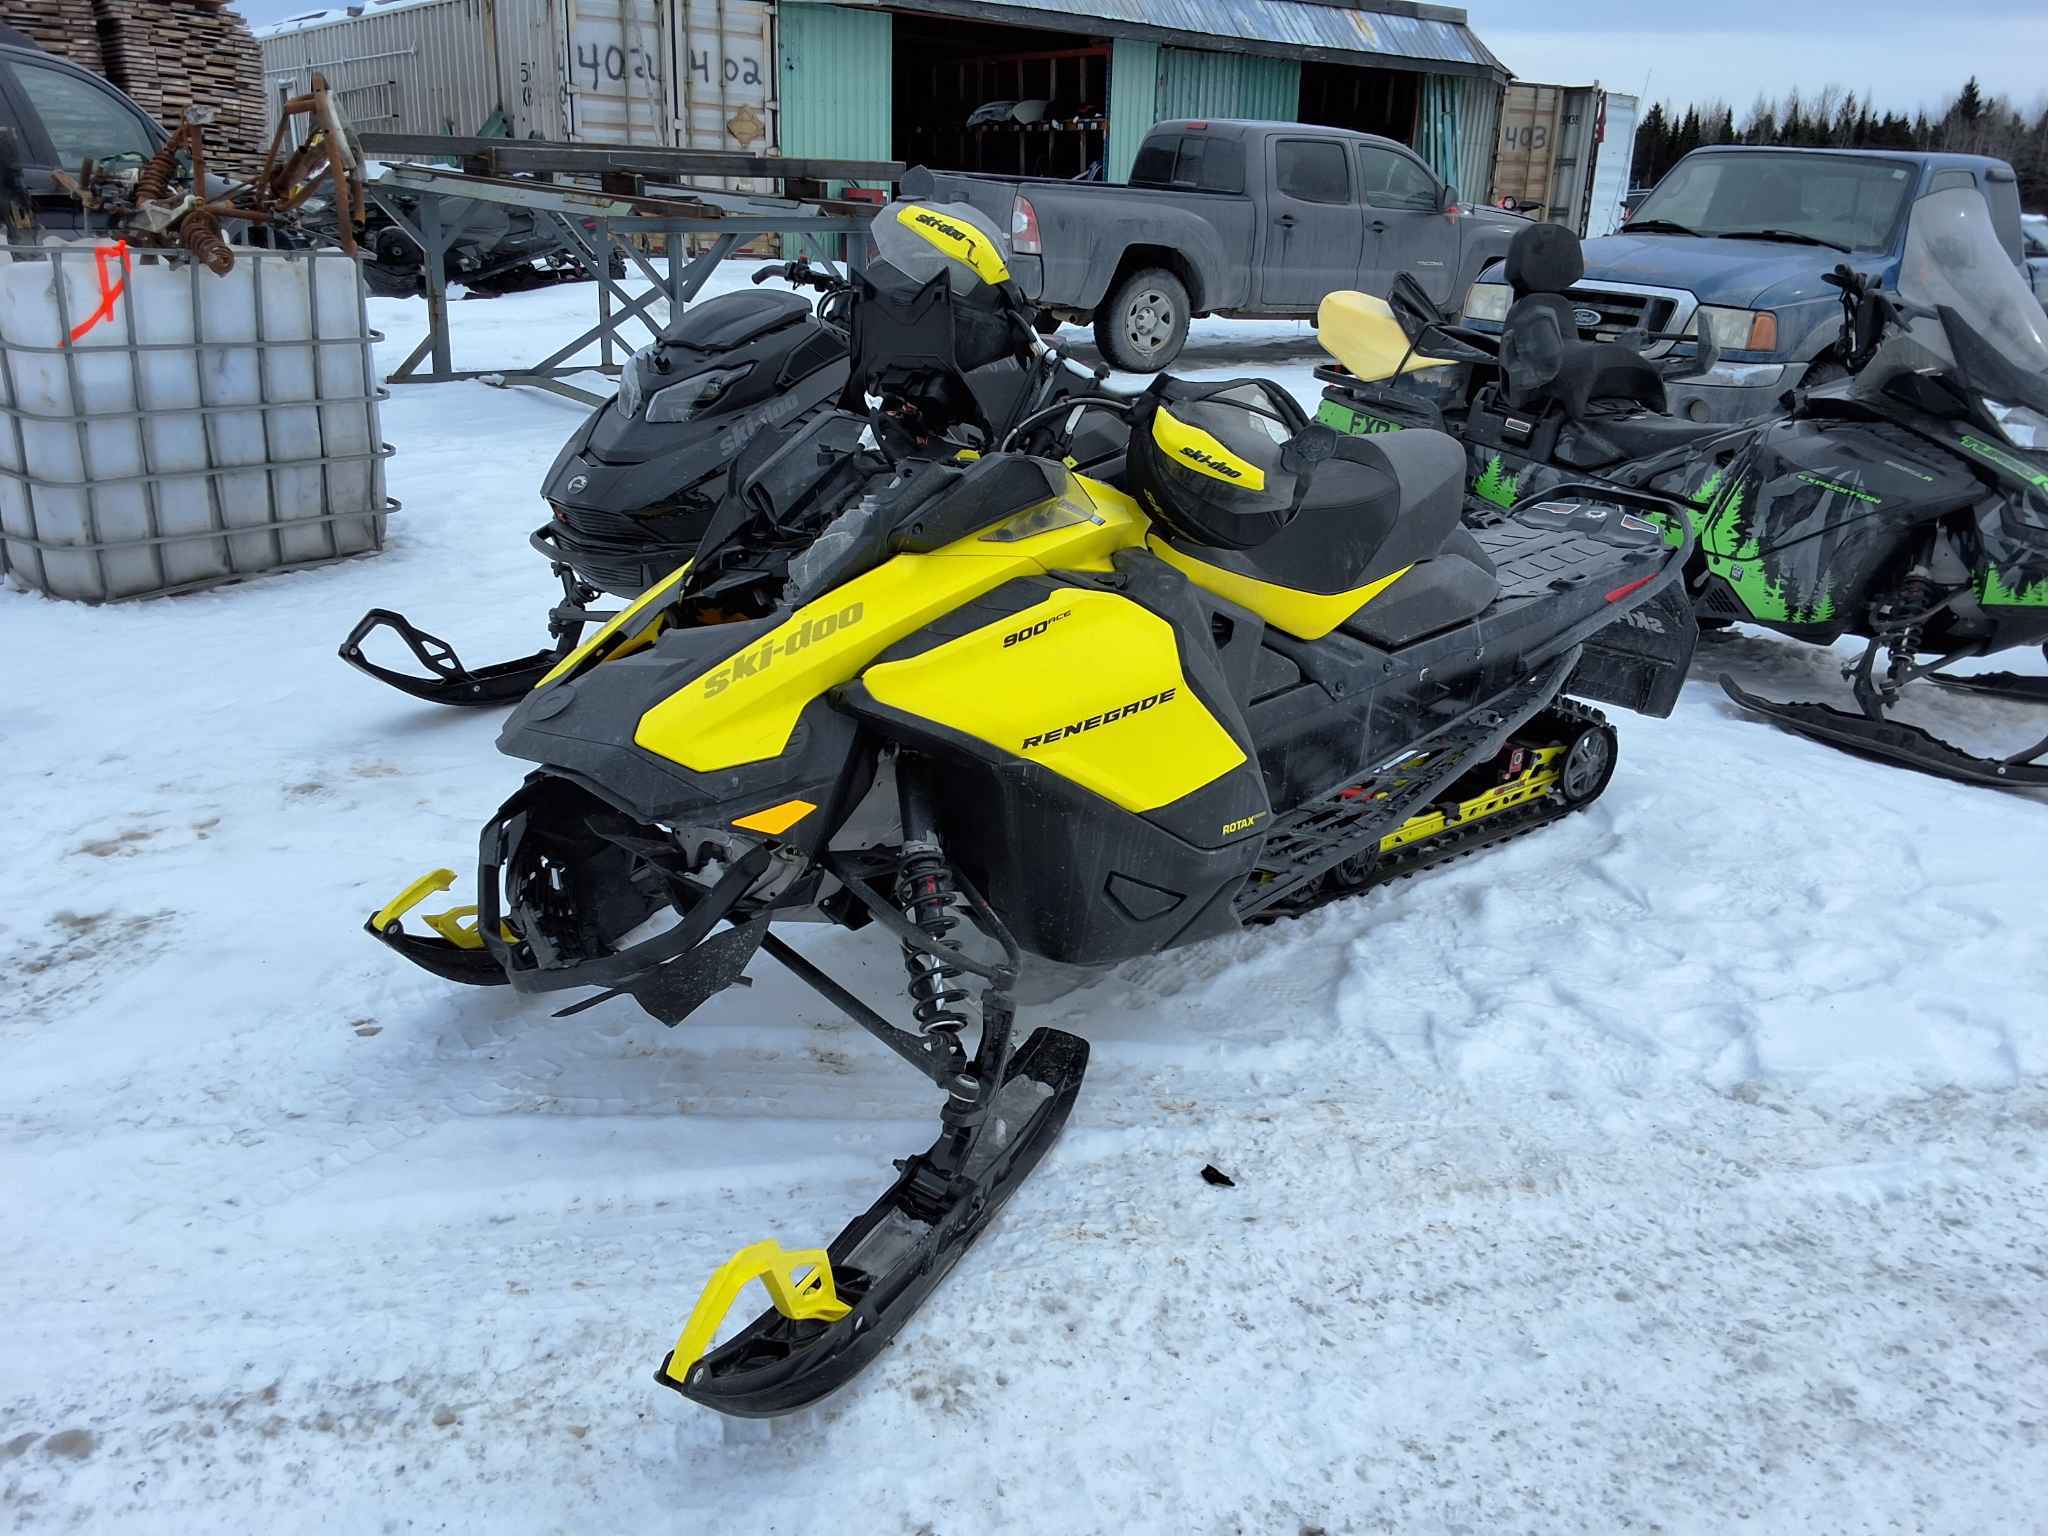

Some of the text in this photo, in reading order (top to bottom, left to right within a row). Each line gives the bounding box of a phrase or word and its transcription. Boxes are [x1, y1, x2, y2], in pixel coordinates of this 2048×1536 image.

[690, 50, 762, 86] 402
[1505, 125, 1546, 151] 403
[1021, 687, 1177, 750] RENEGADE
[1222, 815, 1255, 836] ROTAX
